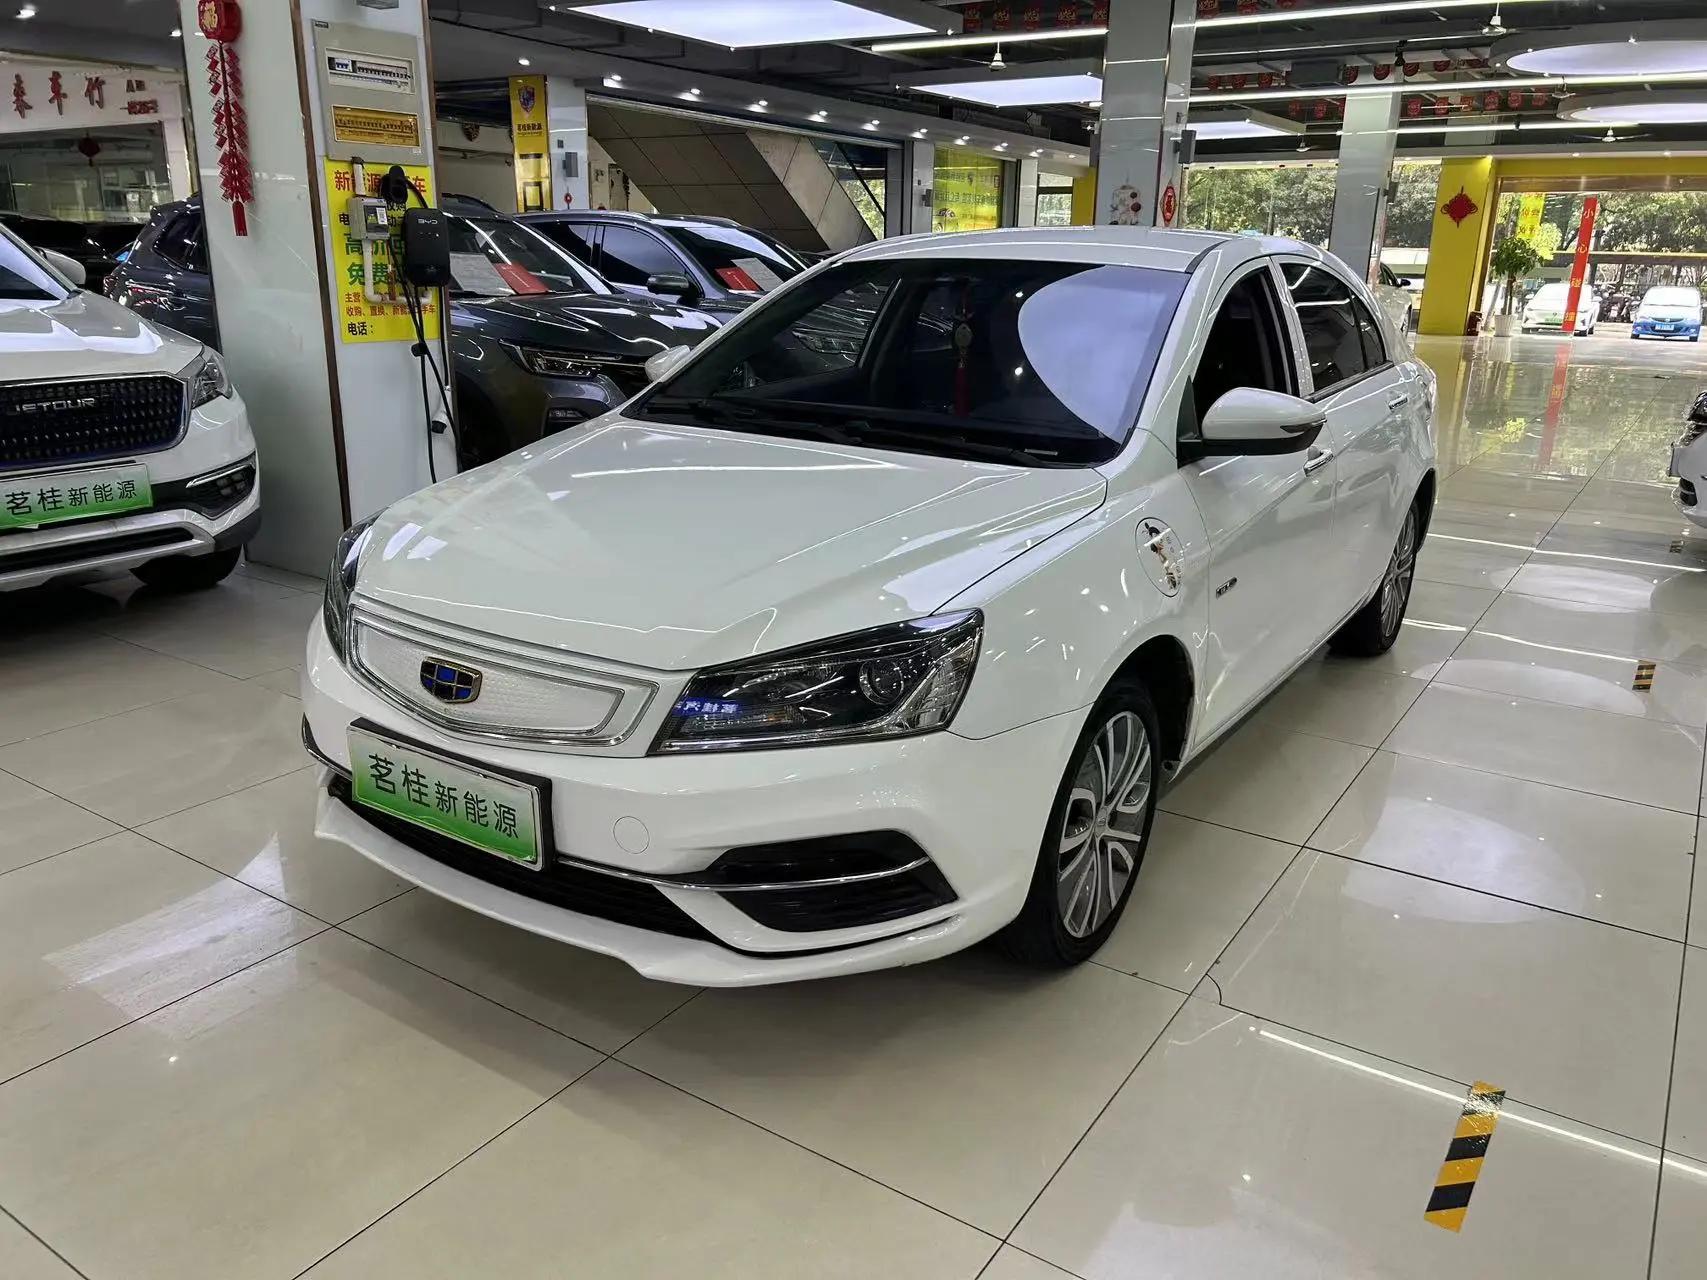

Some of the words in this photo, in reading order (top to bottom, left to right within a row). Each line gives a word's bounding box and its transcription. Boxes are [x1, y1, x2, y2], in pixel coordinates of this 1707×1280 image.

[8, 398, 95, 416] JETOUR
[5, 480, 137, 515] 茗桂新能源
[368, 753, 519, 839] 茗桂新能源
